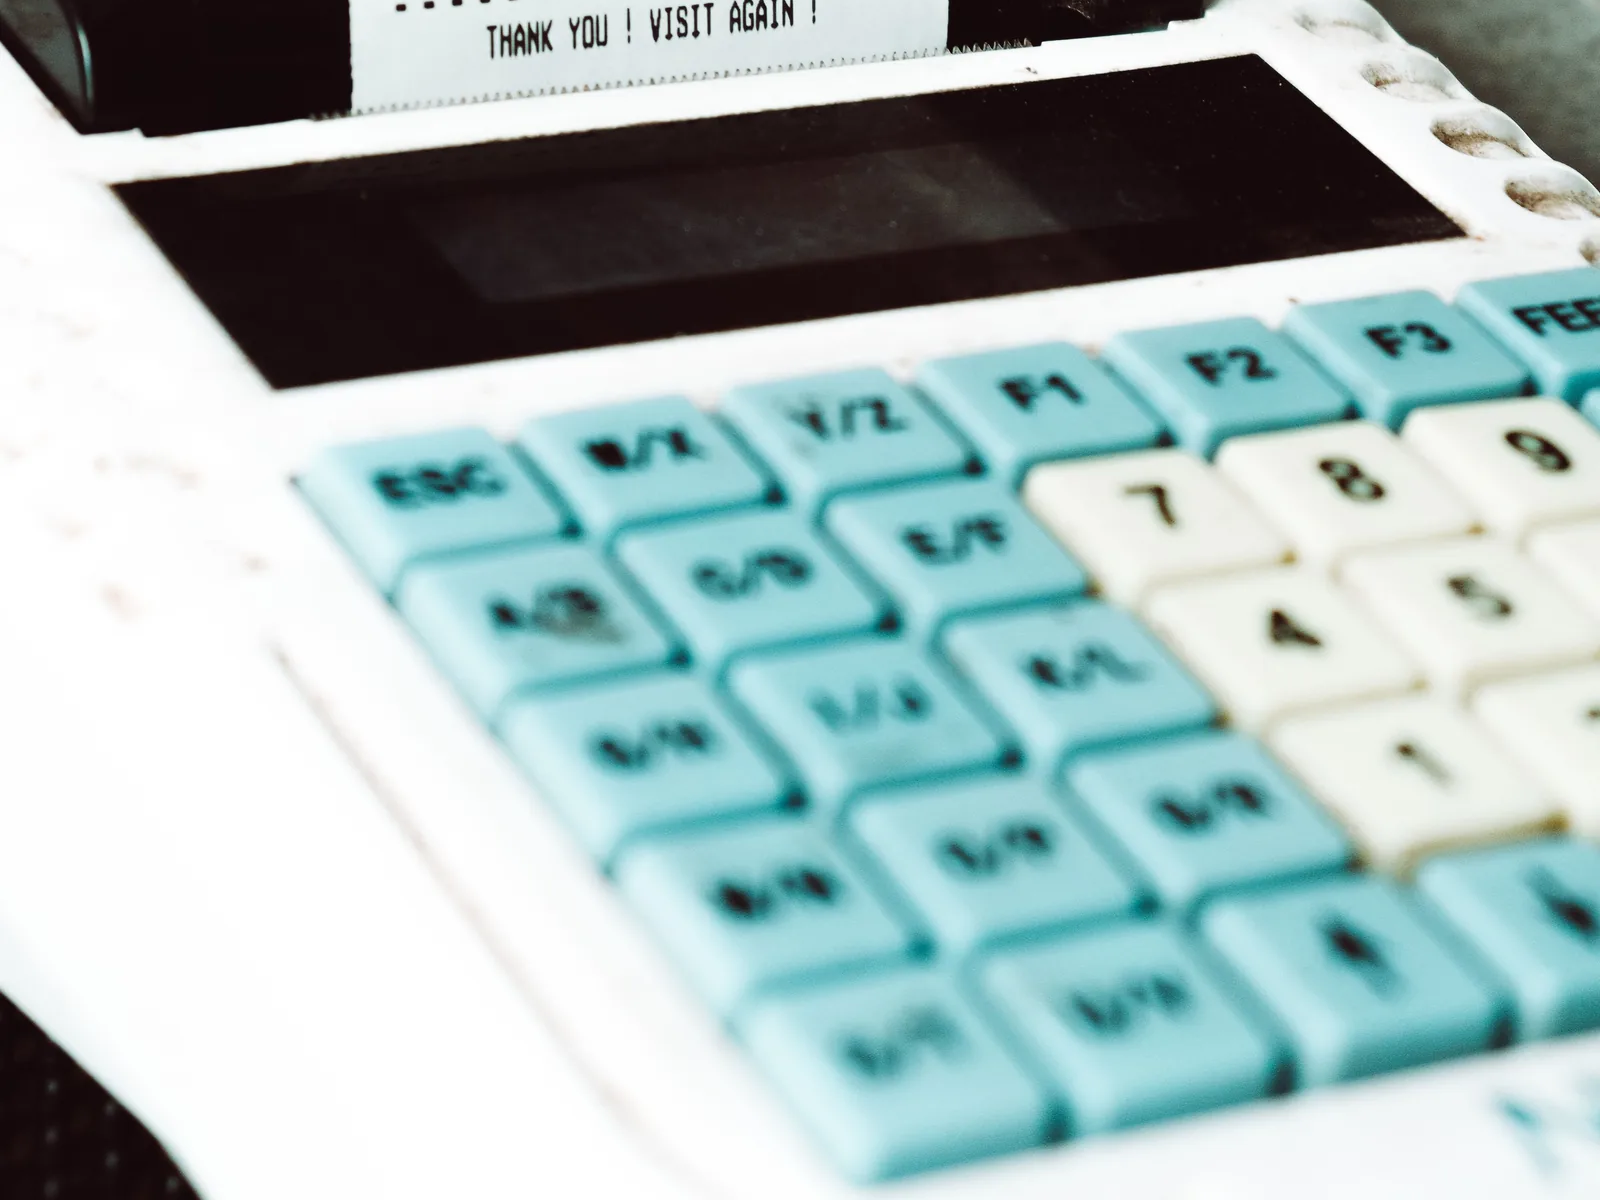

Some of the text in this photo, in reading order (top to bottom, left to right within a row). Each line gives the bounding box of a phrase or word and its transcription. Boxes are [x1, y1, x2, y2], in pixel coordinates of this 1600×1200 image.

[486, 19, 554, 60] THANK
[568, 13, 608, 50] YOU
[649, 2, 715, 43] VISIT
[1364, 321, 1452, 360] F3
[1186, 347, 1278, 386] F2
[999, 373, 1084, 412] F1
[1504, 429, 1573, 473] 9
[1317, 457, 1386, 502] 8
[1124, 484, 1178, 528] 7
[1266, 608, 1324, 650] 4
